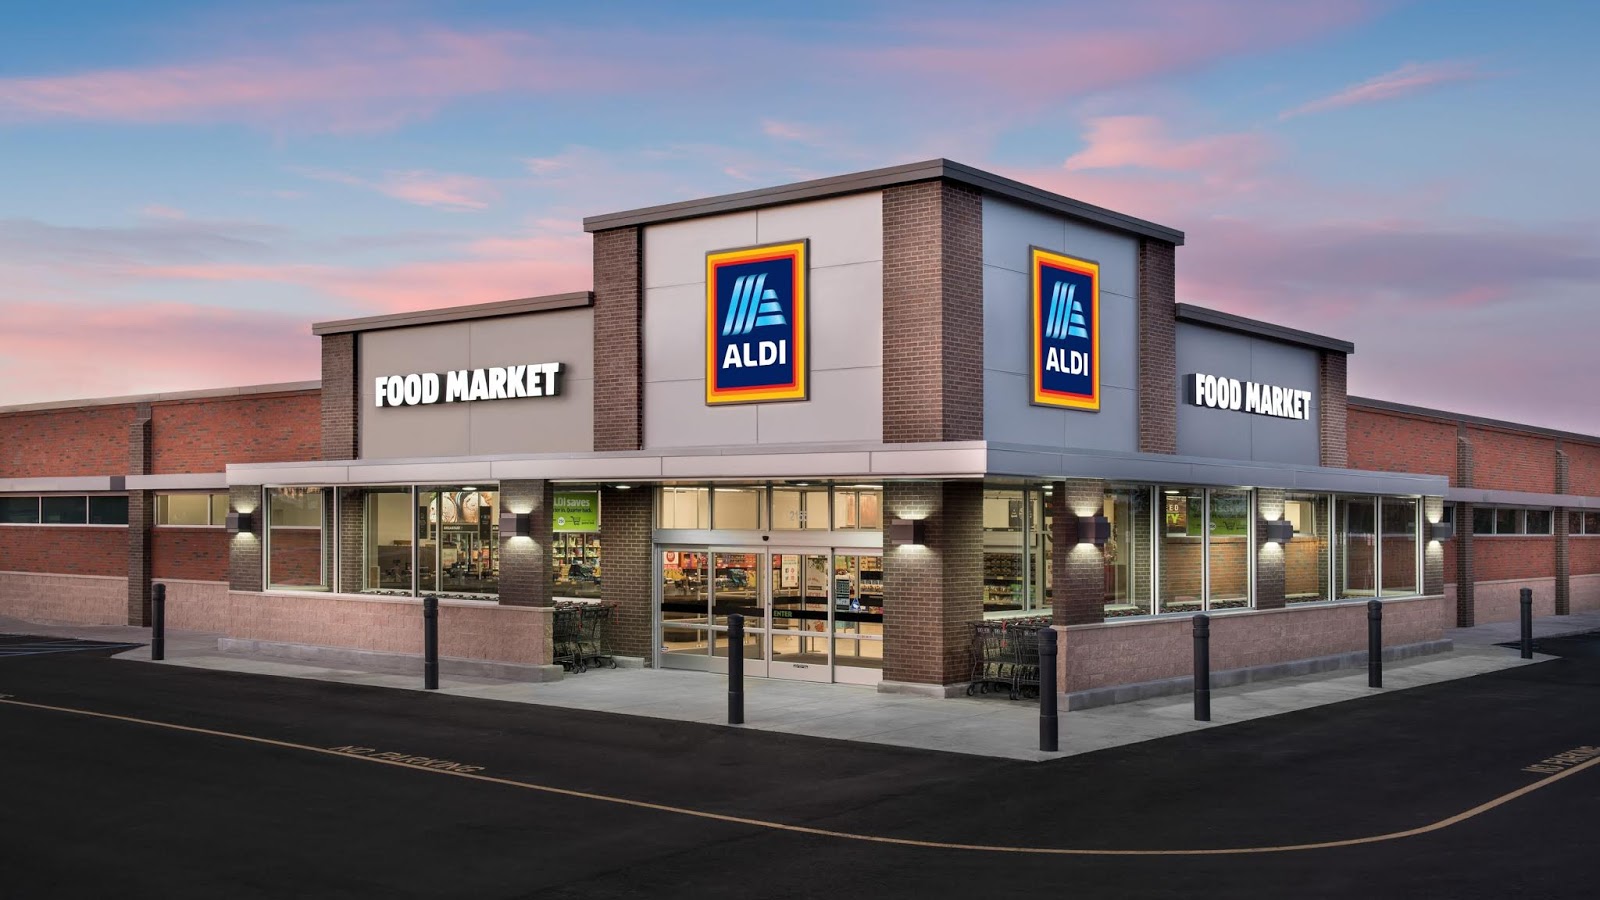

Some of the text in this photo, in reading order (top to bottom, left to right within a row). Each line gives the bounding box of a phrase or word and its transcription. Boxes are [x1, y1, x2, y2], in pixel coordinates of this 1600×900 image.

[722, 340, 786, 369] ALDI
[1046, 347, 1088, 376] ALDI
[375, 362, 559, 407] FOOD MARKET
[1195, 373, 1312, 421] FOOD MARKET
[567, 499, 590, 507] saves
[773, 610, 793, 618] ENTER
[328, 745, 485, 773] NO PARKING
